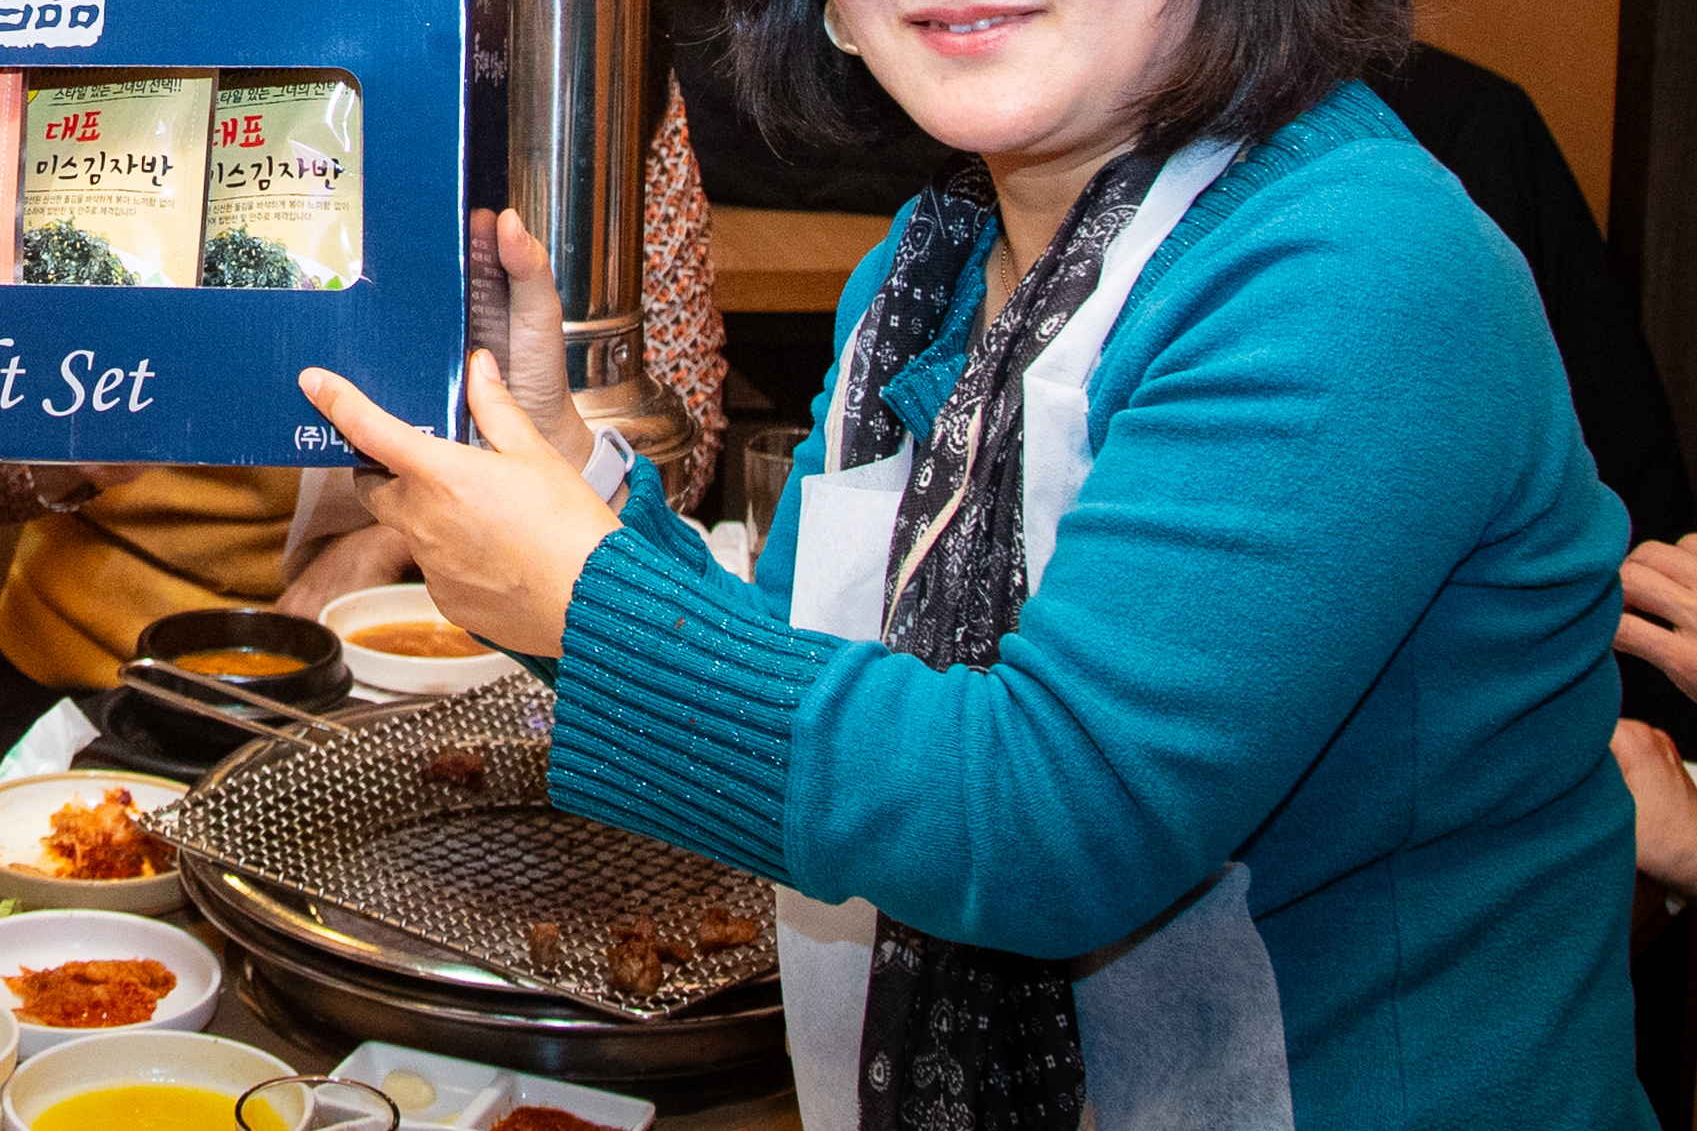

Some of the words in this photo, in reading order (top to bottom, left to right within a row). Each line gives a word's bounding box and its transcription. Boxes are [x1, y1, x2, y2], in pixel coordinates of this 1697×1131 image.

[53, 86, 87, 100] 스타일
[90, 84, 109, 98] 있는
[113, 81, 146, 95] 그녀의
[149, 77, 182, 93] 선택!!
[216, 91, 243, 105] 타일
[247, 88, 270, 101] 있는
[45, 110, 101, 143] 대표
[36, 151, 174, 187] 미스김자반
[85, 195, 113, 205] 바삭하게
[159, 198, 175, 209] 없이
[256, 200, 286, 210] 바삭하게
[333, 201, 349, 211] 없이
[42, 349, 155, 417] Set
